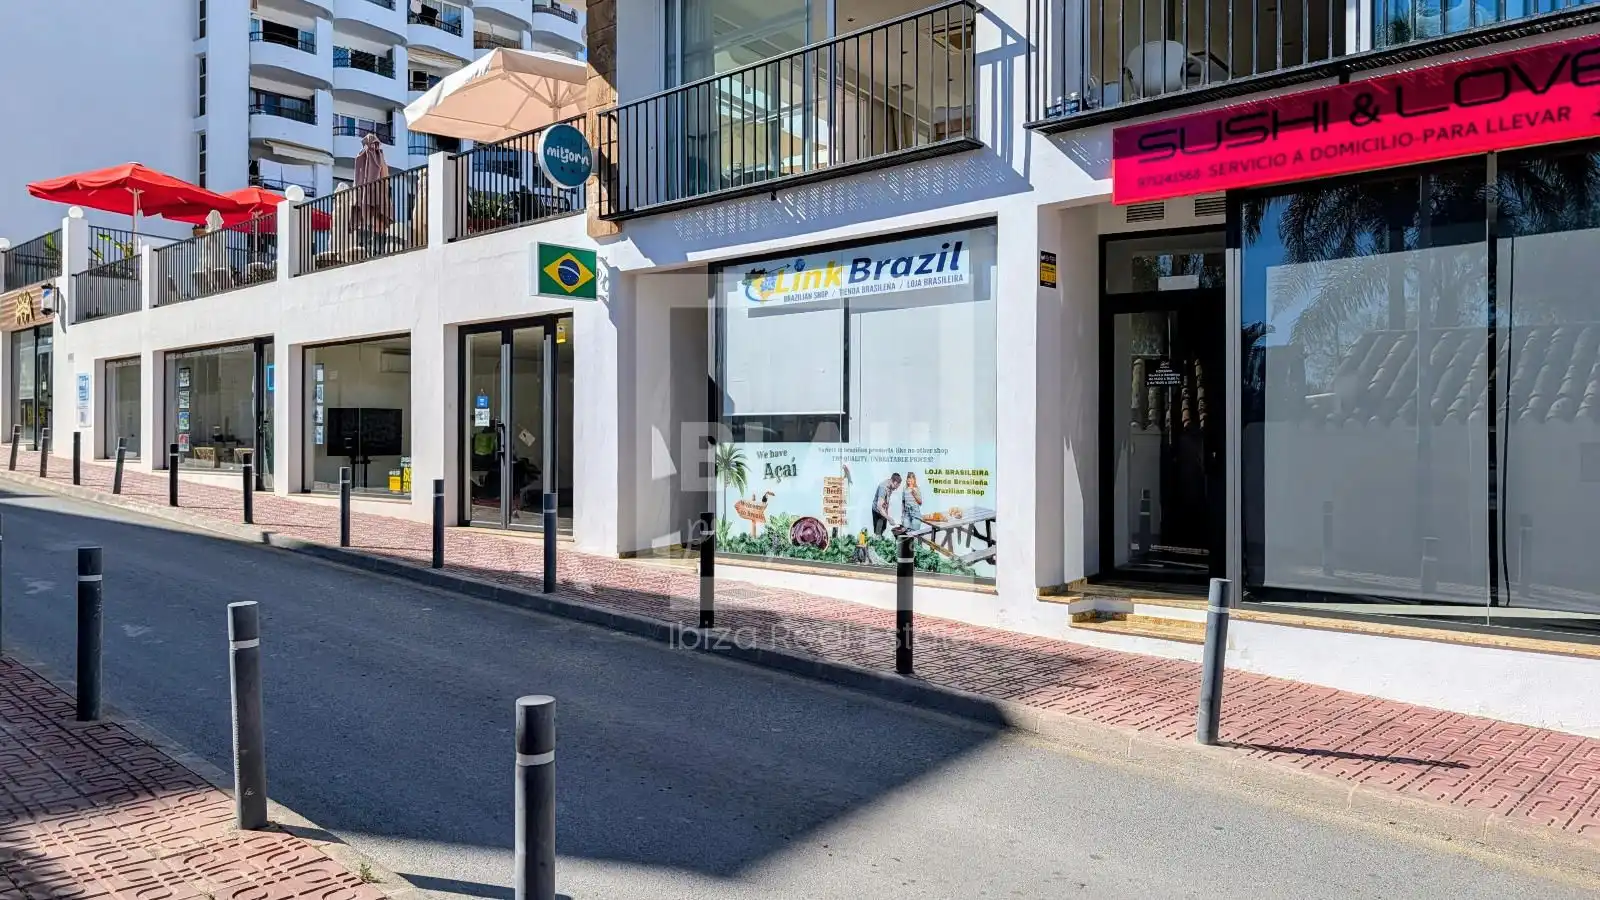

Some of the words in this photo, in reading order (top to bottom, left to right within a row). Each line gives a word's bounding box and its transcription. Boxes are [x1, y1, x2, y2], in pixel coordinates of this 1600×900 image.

[1137, 100, 1329, 165] SUSHI
[1348, 91, 1382, 128] &
[1208, 152, 1288, 178] SERVICIO
[1292, 148, 1305, 165] A
[1485, 105, 1572, 134] LLEVAR
[775, 258, 842, 294] Link
[847, 241, 964, 285] Brazil
[783, 291, 813, 303] BRAZILIAN
[813, 290, 829, 300] SHOP
[907, 277, 922, 289] LOJA
[923, 273, 964, 286] BRASILEIRA
[756, 450, 769, 460] We
[769, 449, 788, 459] have
[933, 447, 949, 455] shop
[763, 456, 798, 483] Açaí
[945, 468, 989, 476] BRASILEIRA
[927, 477, 952, 485] Tienda
[933, 487, 965, 495] Brazilian
[966, 488, 985, 497] Shop
